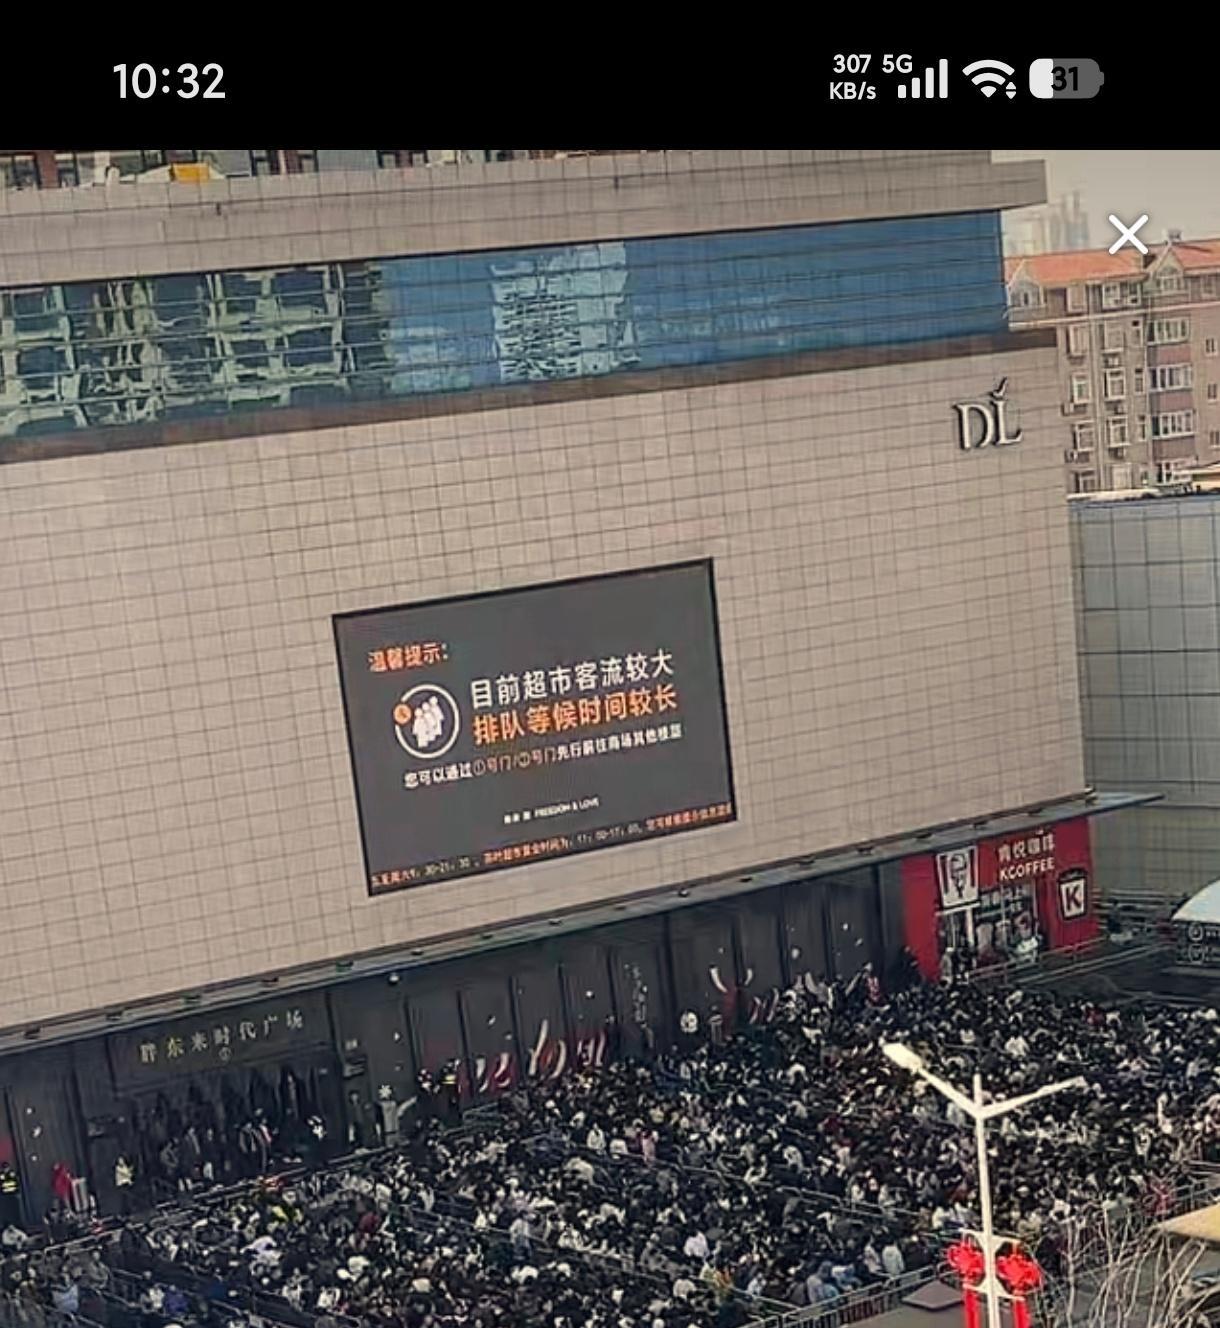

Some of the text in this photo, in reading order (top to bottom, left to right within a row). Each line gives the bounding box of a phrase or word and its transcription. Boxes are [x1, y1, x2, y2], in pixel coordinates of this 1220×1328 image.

[471, 649, 673, 709] 目前超市客流较大
[473, 684, 677, 745] 排队等候时间较长
[999, 857, 1055, 880] KCOFFEE
[1064, 884, 1083, 911] K
[140, 1010, 303, 1063] 胖东来时代广场
